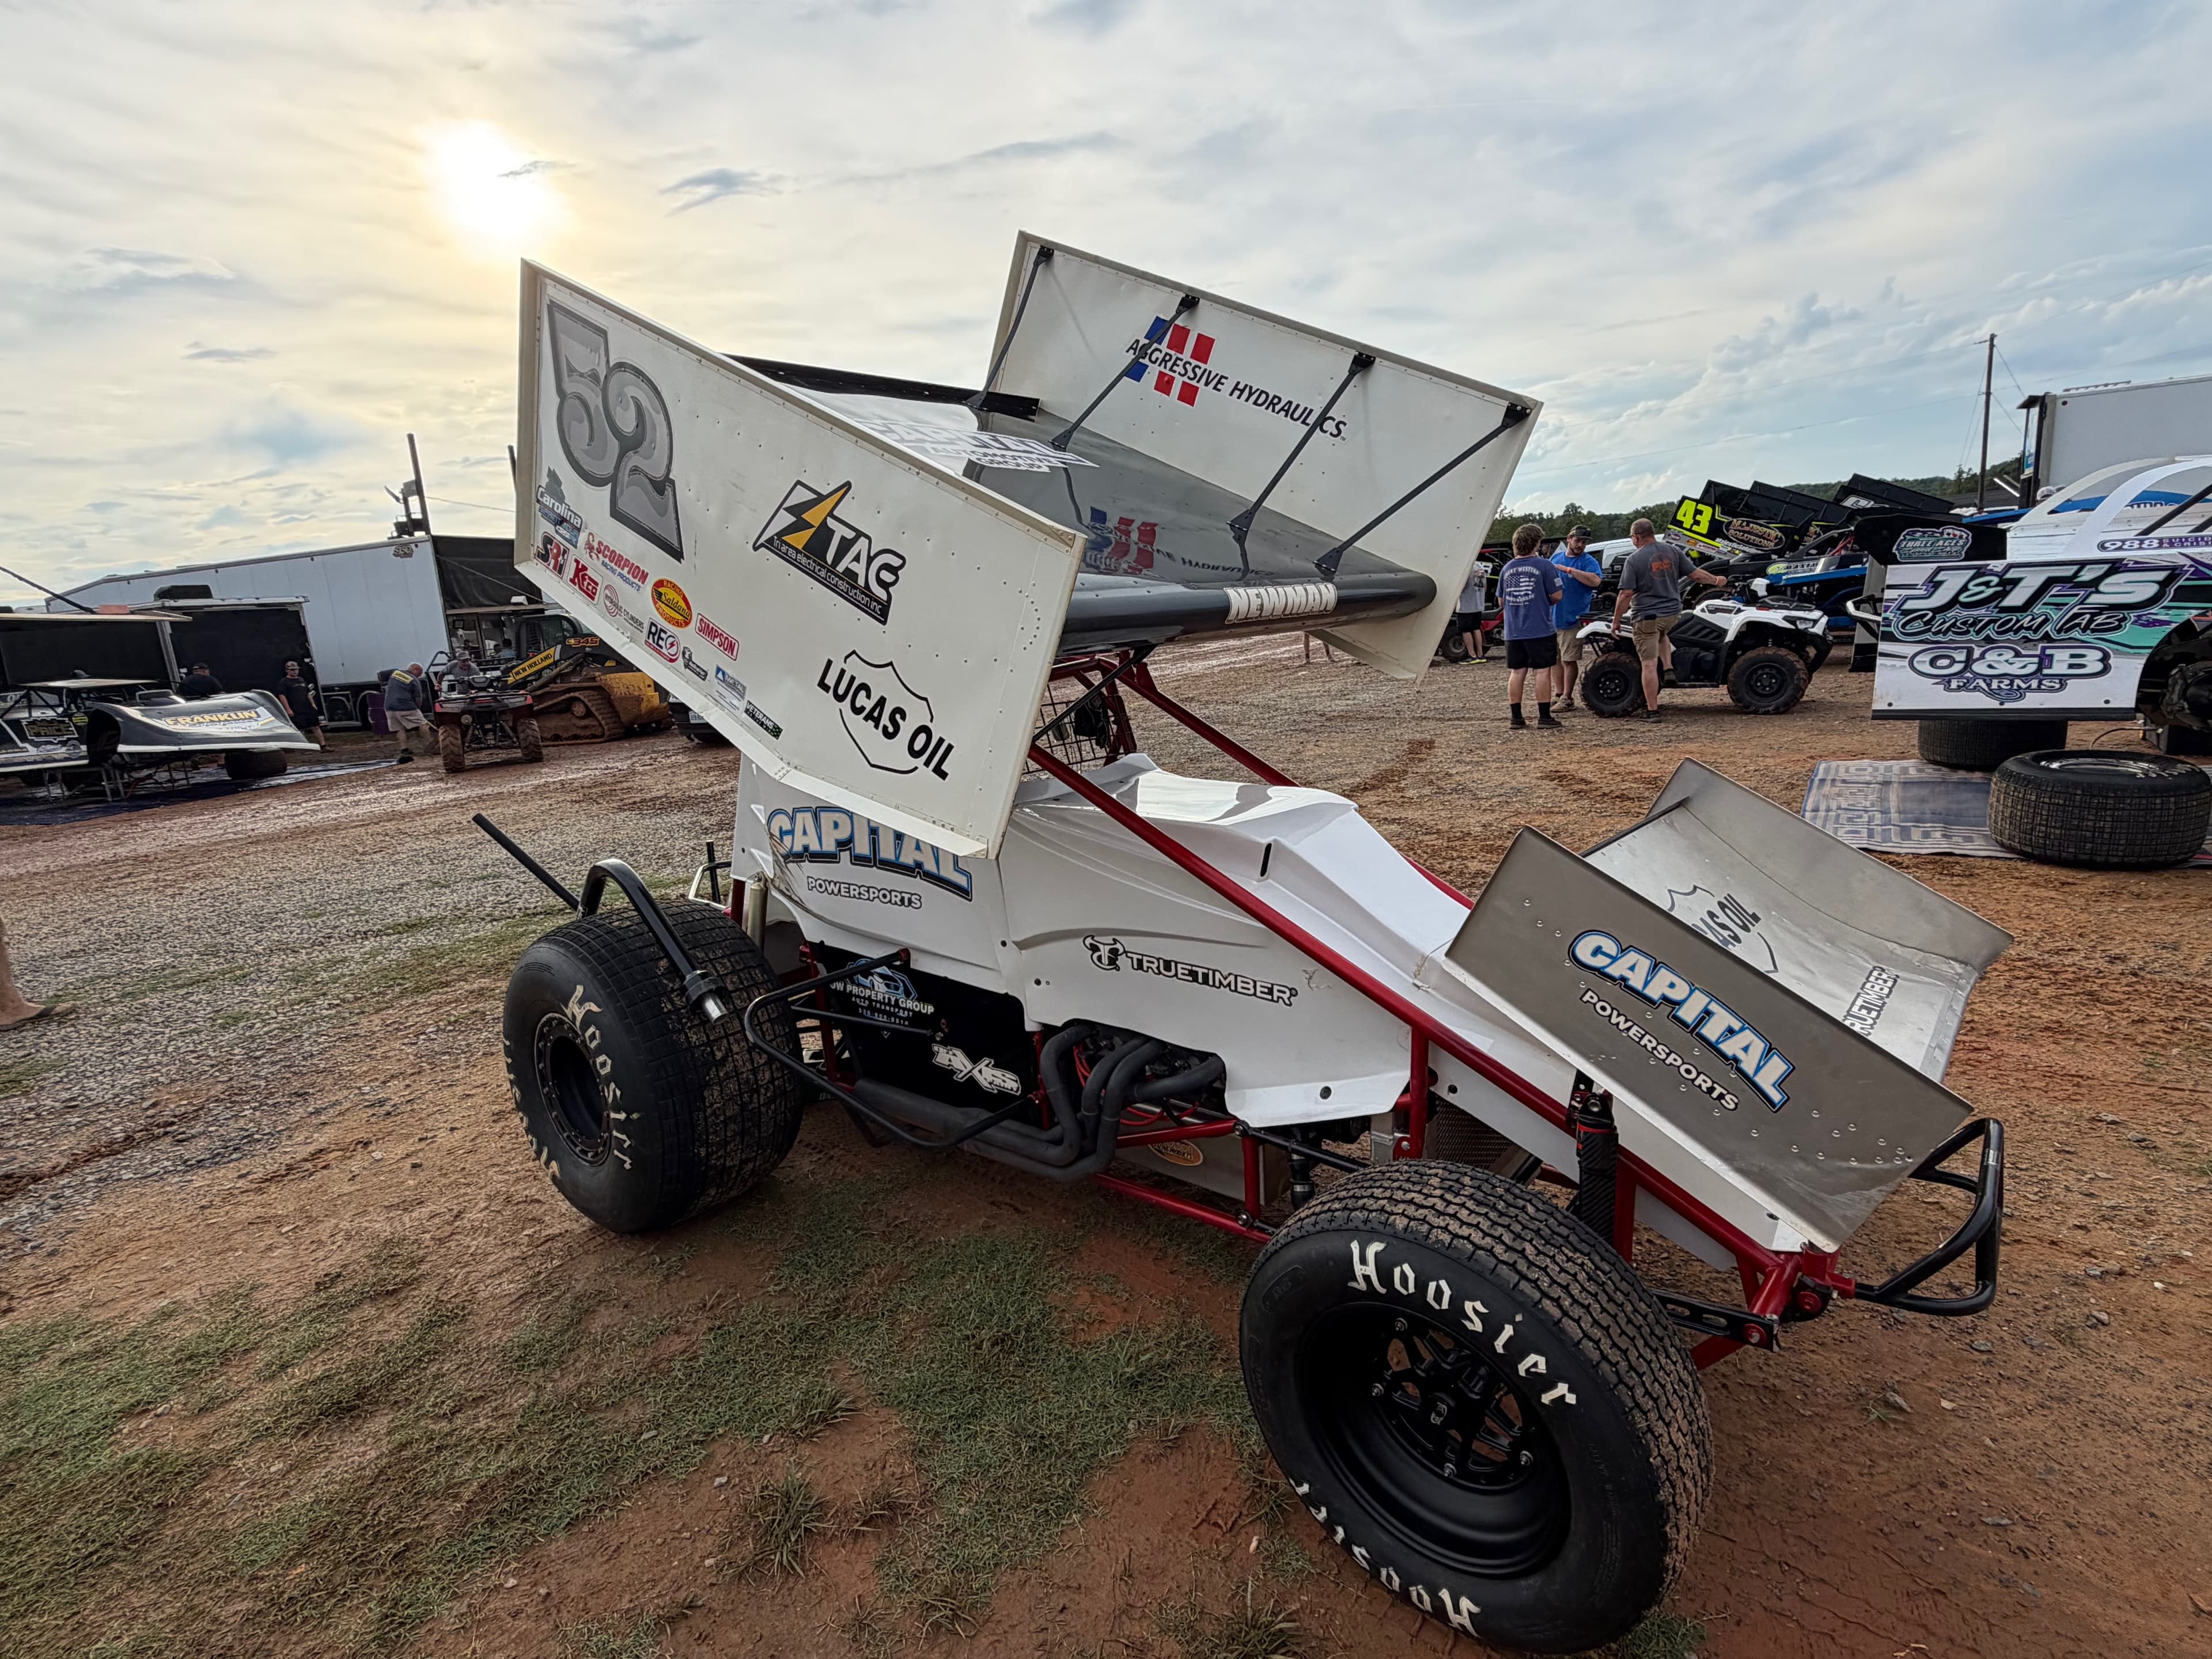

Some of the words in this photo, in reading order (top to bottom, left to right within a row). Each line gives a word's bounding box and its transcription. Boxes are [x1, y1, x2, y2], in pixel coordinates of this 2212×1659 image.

[1125, 338, 1229, 393] AGGRESSIVE
[1229, 380, 1347, 439] HYDRAULCS
[547, 299, 684, 564] 52
[537, 487, 581, 529] Carolina
[1676, 499, 1713, 535] 43
[596, 540, 649, 585] SCORPION
[2104, 539, 2160, 551] 988
[601, 560, 617, 575] RACING
[617, 571, 642, 592] PRODUCTS
[664, 580, 683, 598] RACING
[781, 542, 796, 560] area
[797, 552, 827, 579] electrical
[827, 573, 870, 608] construction
[871, 599, 882, 615] inc
[1903, 565, 2172, 611] J&T'S
[656, 603, 685, 627] PRODUCTS
[662, 592, 691, 619] Saldana
[1224, 582, 1337, 624] NEWMAN
[698, 618, 736, 657] SIMPSON
[514, 668, 528, 677] NEW
[528, 653, 553, 671] HOLLAND
[1912, 646, 2107, 676] C&B
[1948, 678, 2061, 691] FARMS
[164, 710, 258, 726] FRANKLIN
[747, 702, 774, 729] VETERANS
[817, 658, 907, 741] LUCAS
[907, 724, 955, 781] OIL
[768, 806, 972, 902] CAPITAL
[807, 876, 922, 909] POWERSPORTS
[1718, 893, 1762, 933] OIL
[1125, 950, 1293, 1006] TRUETIMBER
[846, 984, 897, 1005] PROPERTY
[899, 998, 935, 1015] GROUP
[851, 997, 869, 1006] AUTO
[872, 1002, 913, 1017] TRANSPORT
[1842, 965, 1899, 1037] RUETIMBER
[1568, 929, 1796, 1113] CAPITAL
[1580, 988, 1740, 1111] POWERSPORTS
[560, 984, 641, 1170] Hoosier
[1347, 1238, 1577, 1406] Hoosier
